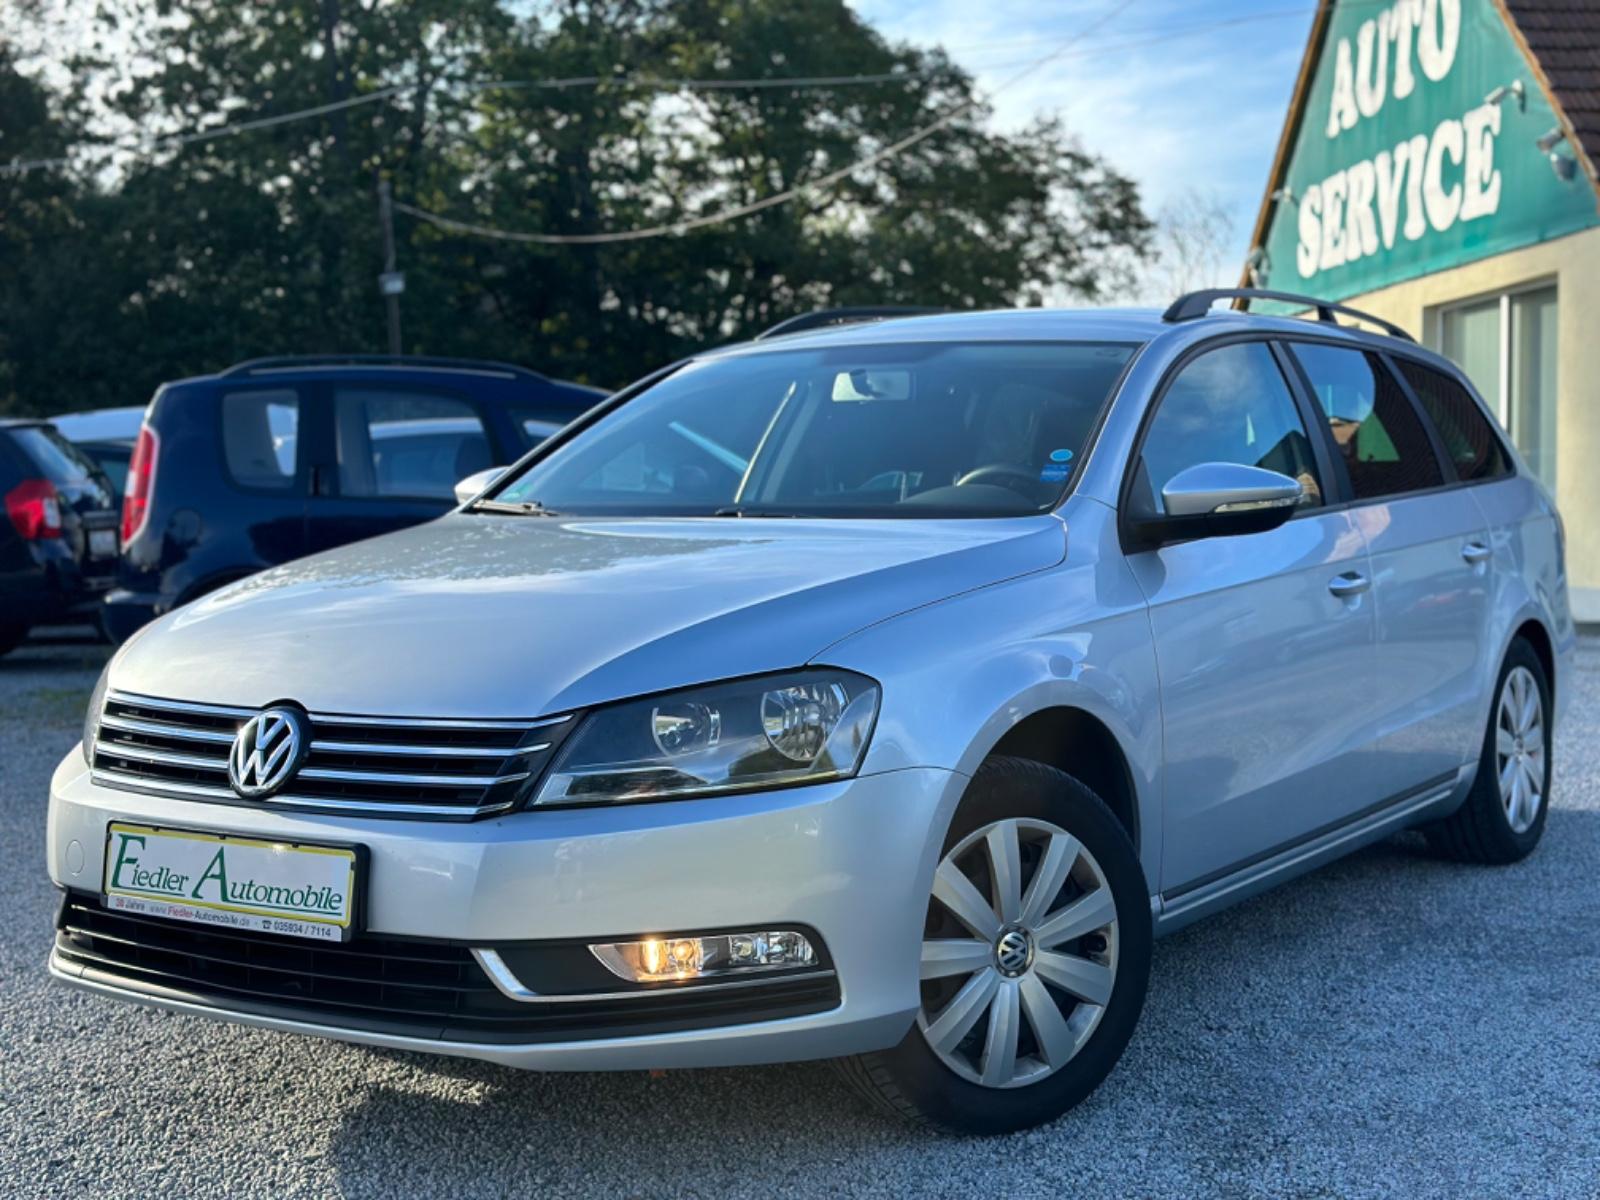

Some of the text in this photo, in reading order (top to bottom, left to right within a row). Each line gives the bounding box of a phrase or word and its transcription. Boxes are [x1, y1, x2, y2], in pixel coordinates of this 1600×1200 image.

[1326, 0, 1461, 138] AUTO
[1297, 103, 1501, 278] SERVICE
[230, 709, 300, 796] VW
[111, 833, 342, 912] Fiedler Automobile
